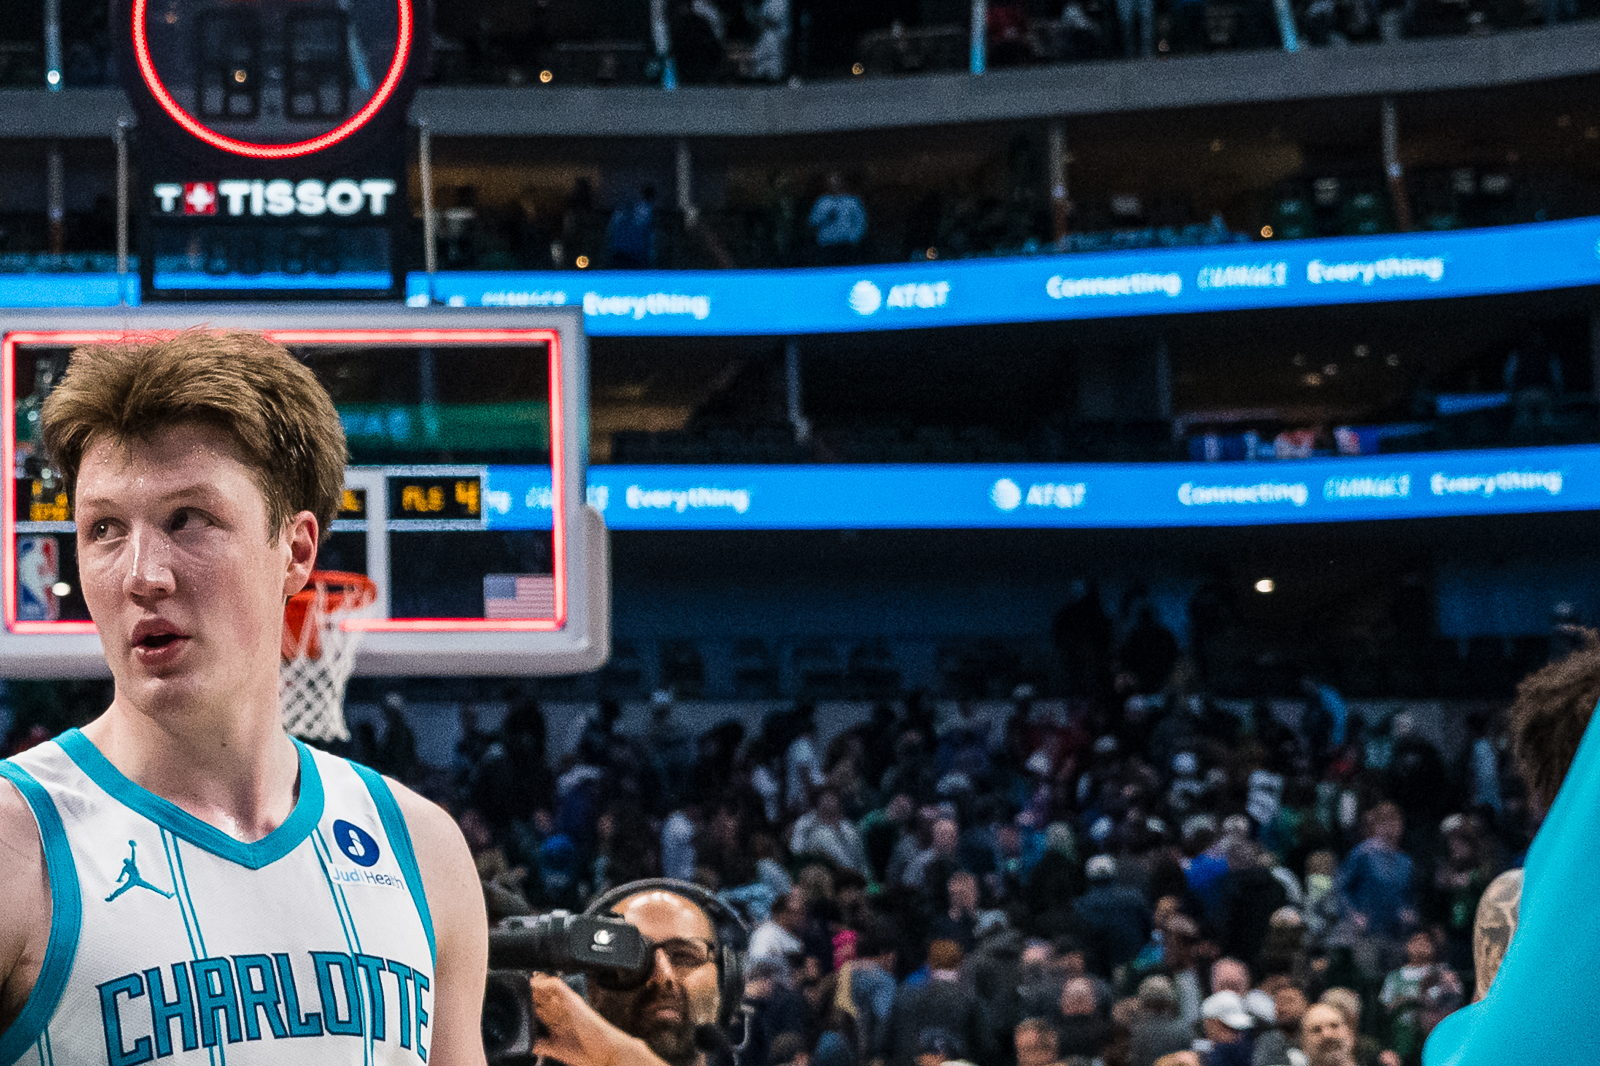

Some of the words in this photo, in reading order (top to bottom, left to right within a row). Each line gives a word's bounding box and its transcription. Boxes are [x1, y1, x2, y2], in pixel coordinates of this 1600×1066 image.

[218, 178, 397, 217] TISSOT
[887, 281, 951, 308] AT&T
[1026, 483, 1086, 508] AT&T
